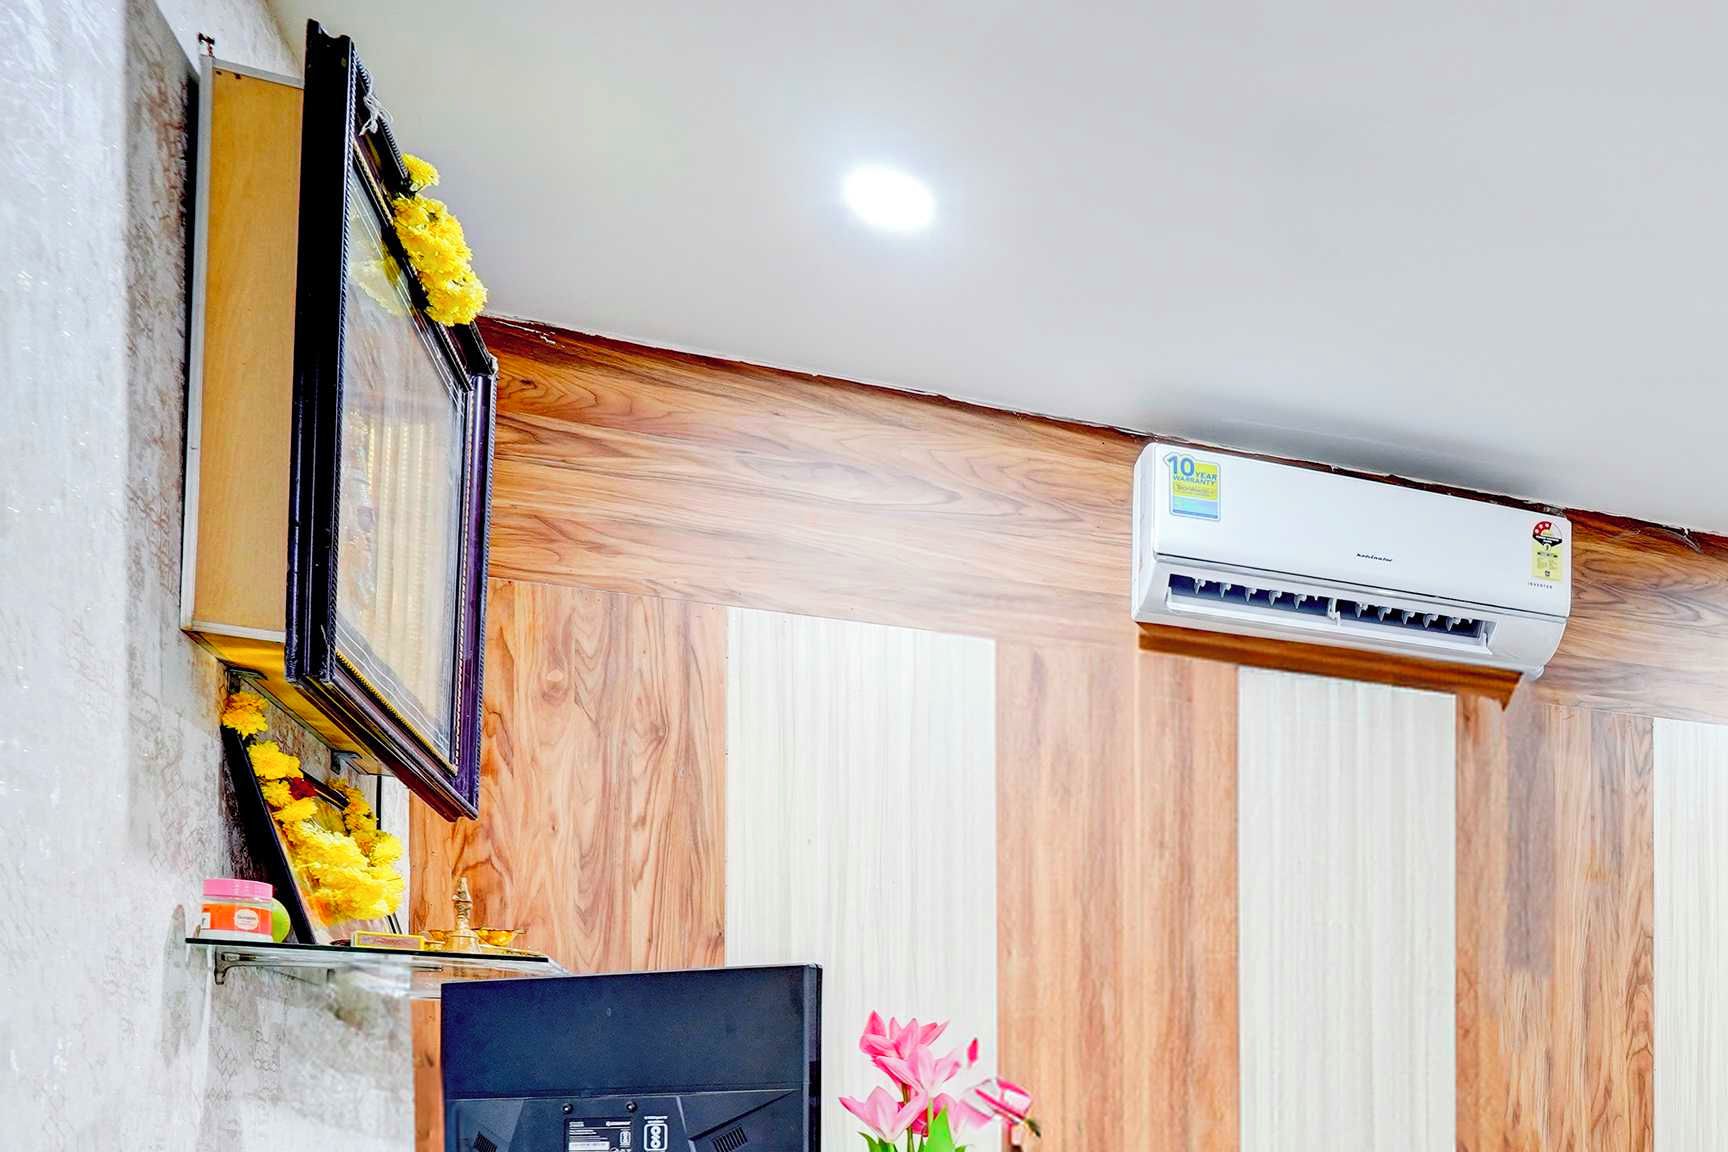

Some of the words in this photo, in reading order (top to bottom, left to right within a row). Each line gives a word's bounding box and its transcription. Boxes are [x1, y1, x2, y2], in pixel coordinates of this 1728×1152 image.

[1167, 455, 1194, 476] 10
[1196, 471, 1217, 482] YEAR
[1173, 474, 1215, 485] WARRANTY
